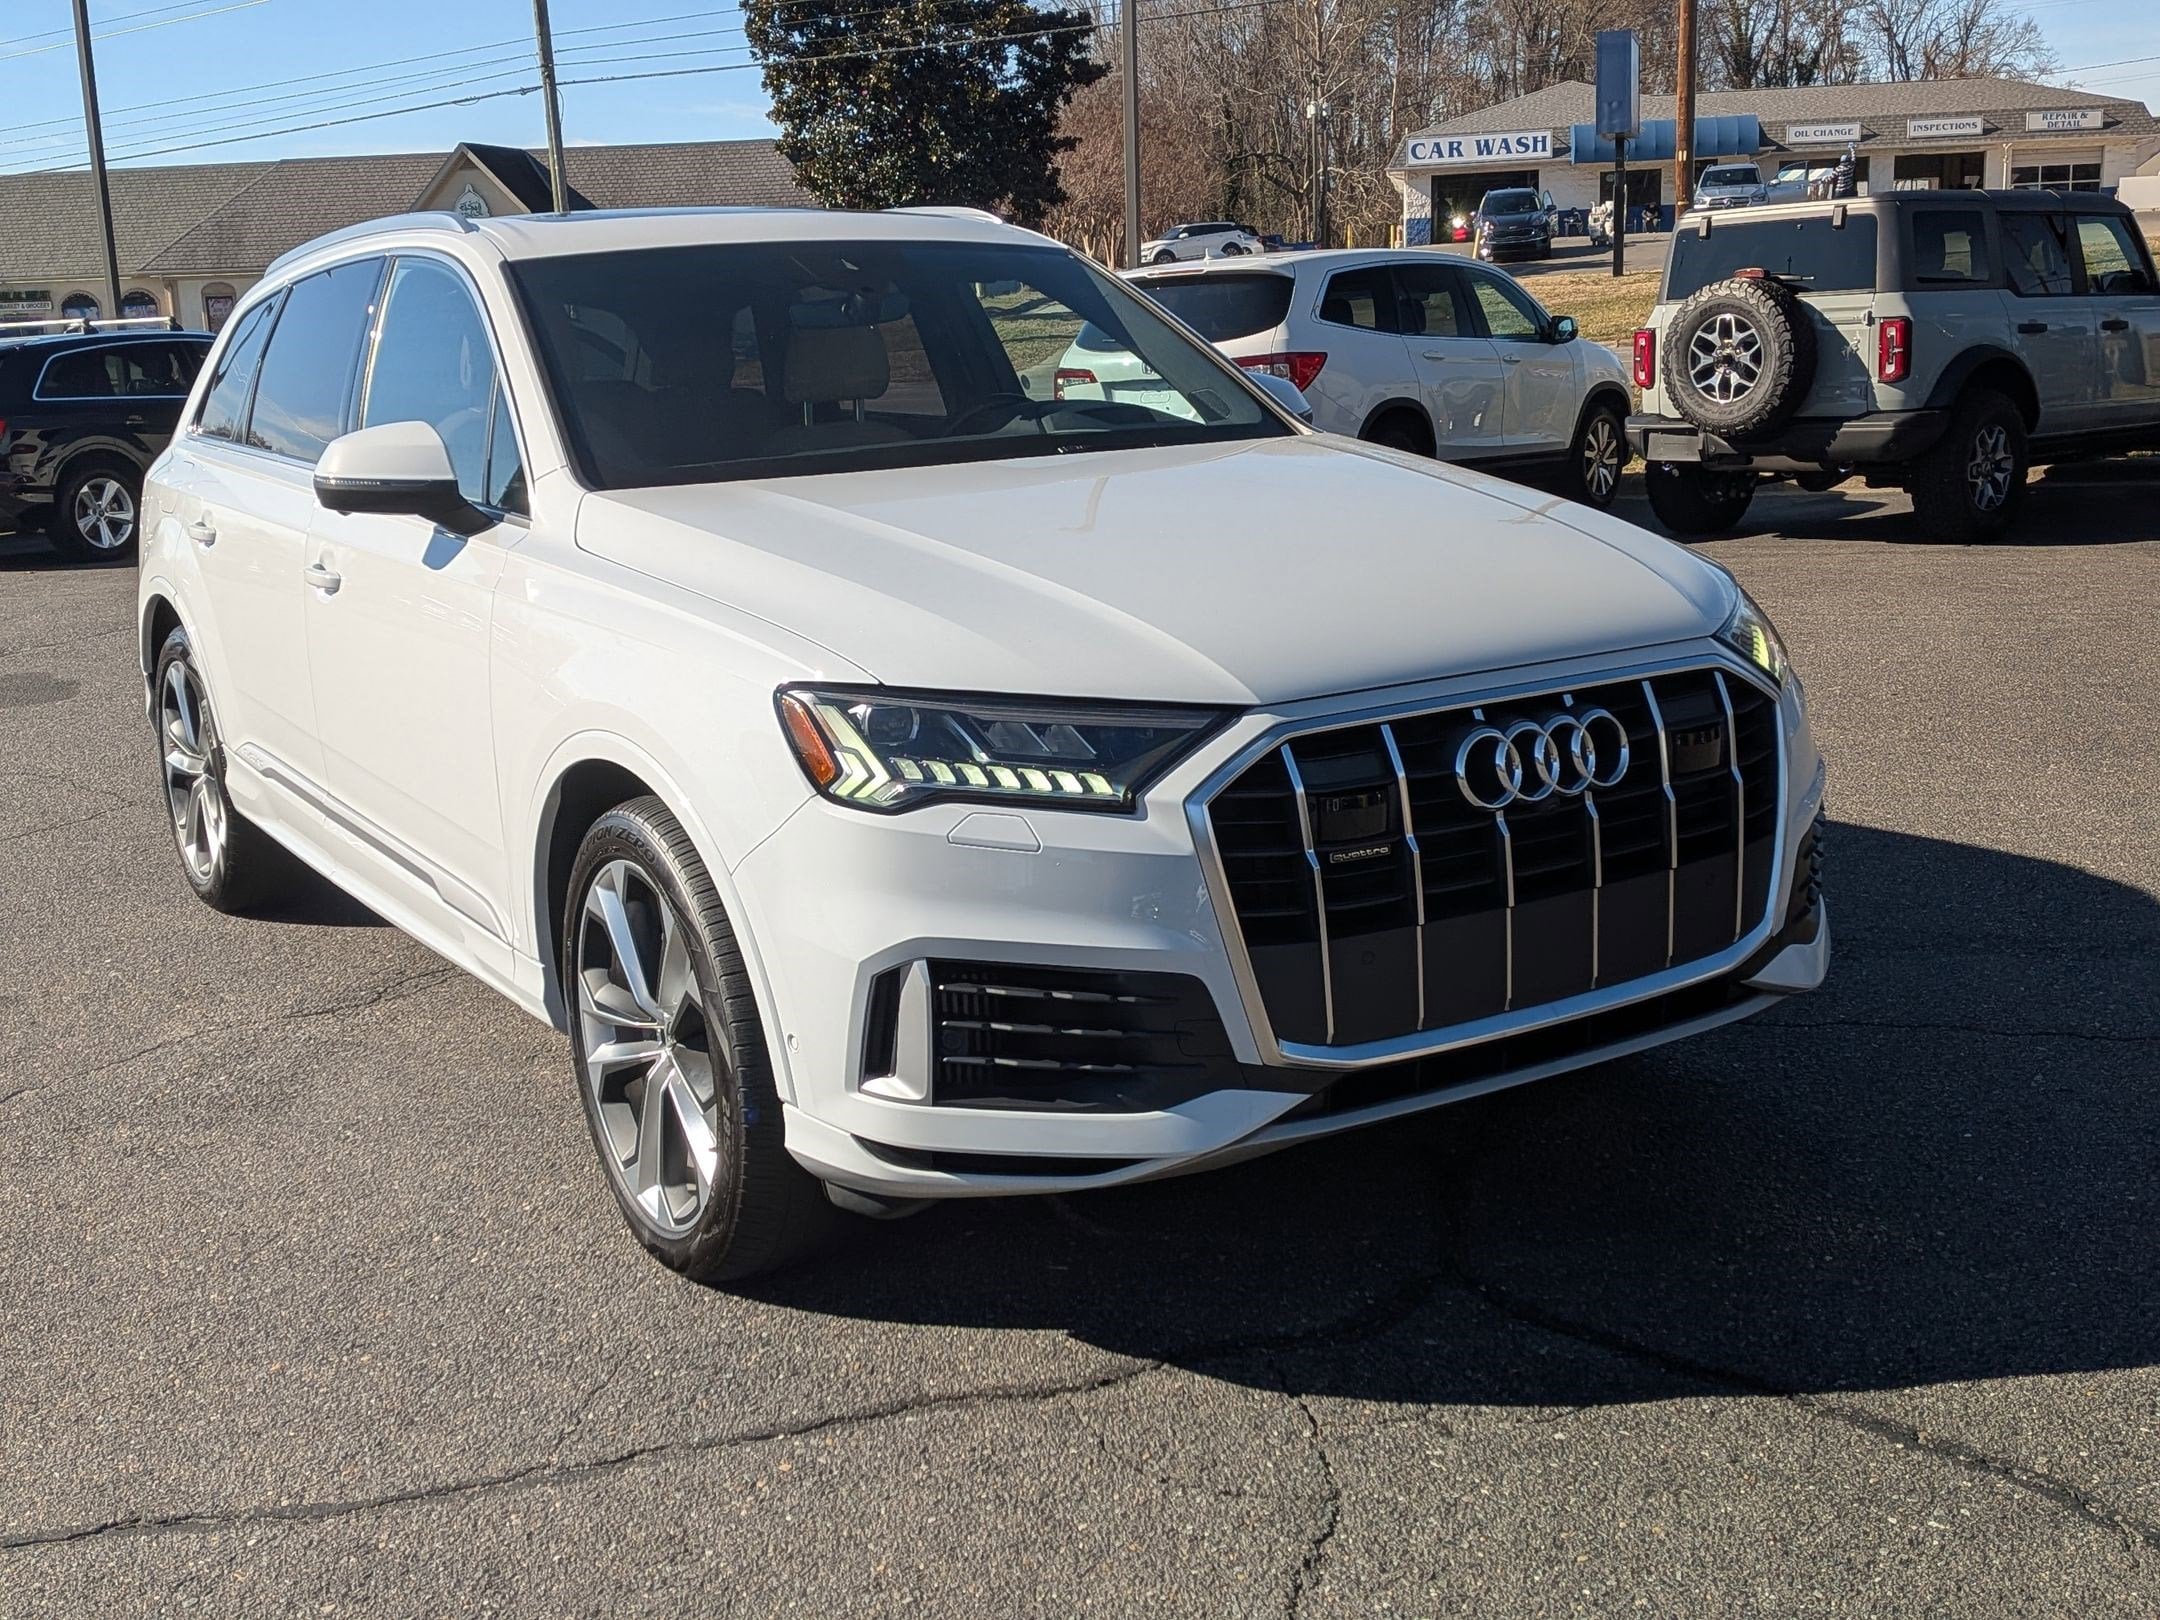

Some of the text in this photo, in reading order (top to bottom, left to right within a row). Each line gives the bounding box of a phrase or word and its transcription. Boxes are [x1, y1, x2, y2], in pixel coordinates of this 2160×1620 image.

[2042, 112, 2078, 121] REPAIR
[1913, 121, 1978, 132] INSPECTIONS
[2047, 120, 2081, 128] DETAIL
[1794, 128, 1854, 138] OIL CHANGE
[1410, 135, 1548, 160] CAR WASH
[615, 827, 656, 864] ZERO
[1333, 846, 1389, 862] quattro
